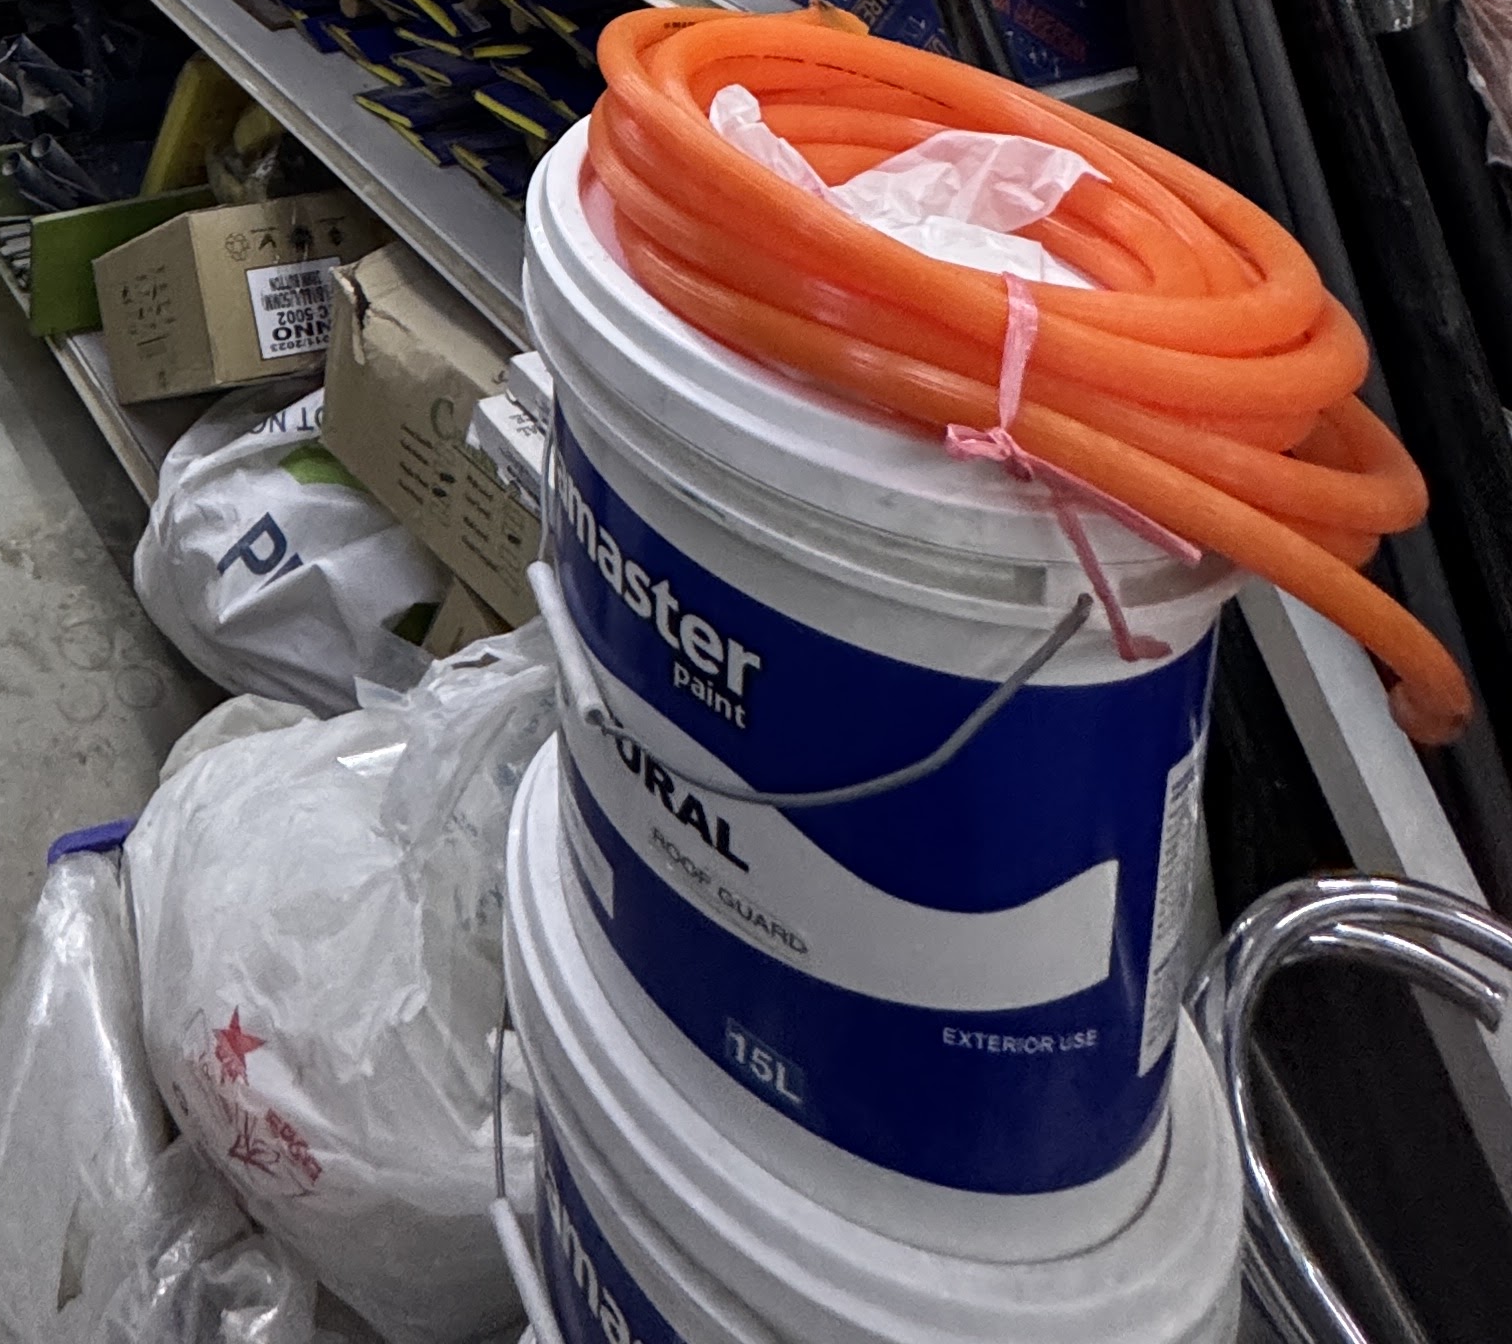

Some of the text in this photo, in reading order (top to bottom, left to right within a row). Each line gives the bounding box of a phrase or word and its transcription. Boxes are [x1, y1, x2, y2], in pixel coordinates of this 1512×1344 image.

[276, 307, 314, 326] 5002
[672, 660, 747, 730] paint
[649, 826, 809, 956] ROOF GUARD
[727, 1027, 804, 1105] 15L
[941, 1025, 1099, 1055] EXTERIOR USE
